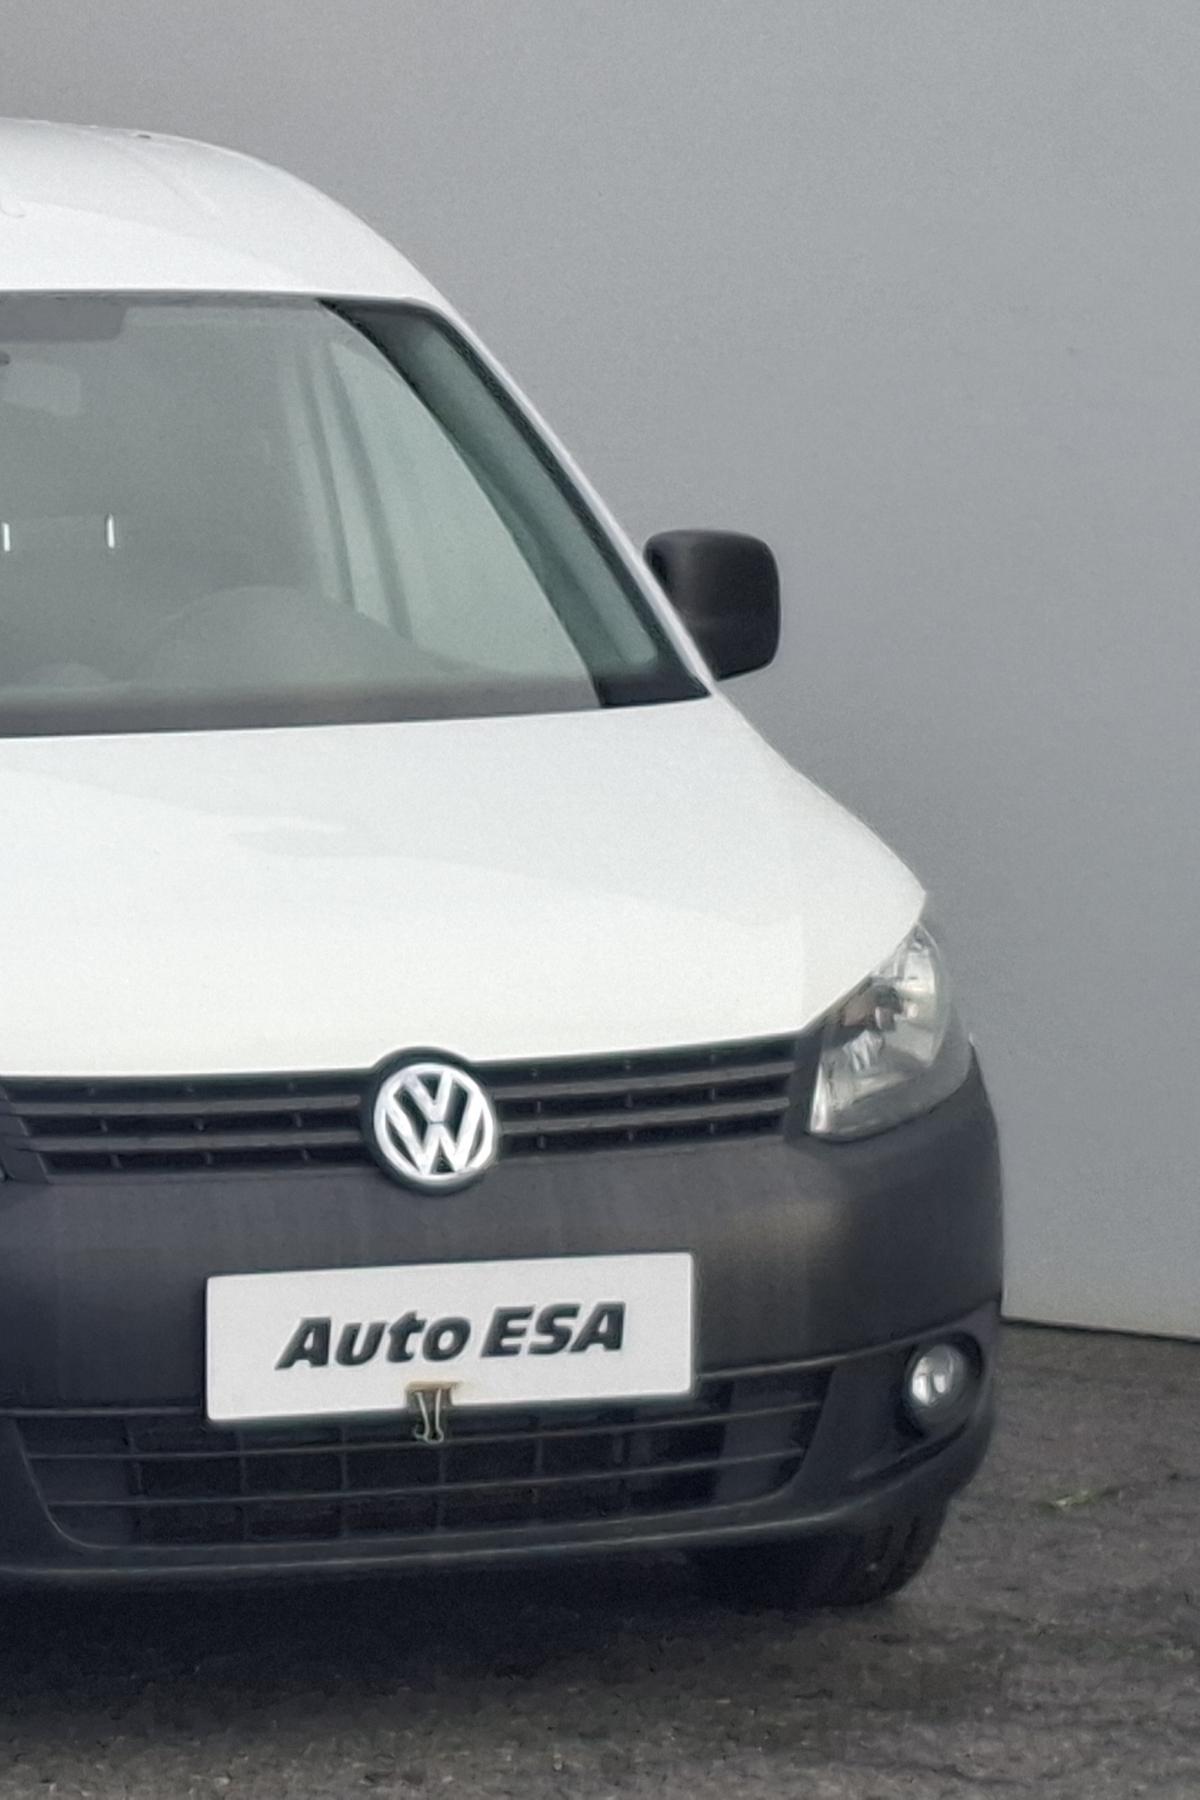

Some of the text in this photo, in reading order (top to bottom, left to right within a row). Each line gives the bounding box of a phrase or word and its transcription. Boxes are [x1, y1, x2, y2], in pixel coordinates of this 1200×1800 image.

[378, 1066, 491, 1180] VW
[275, 1303, 626, 1370] Auto ESA
